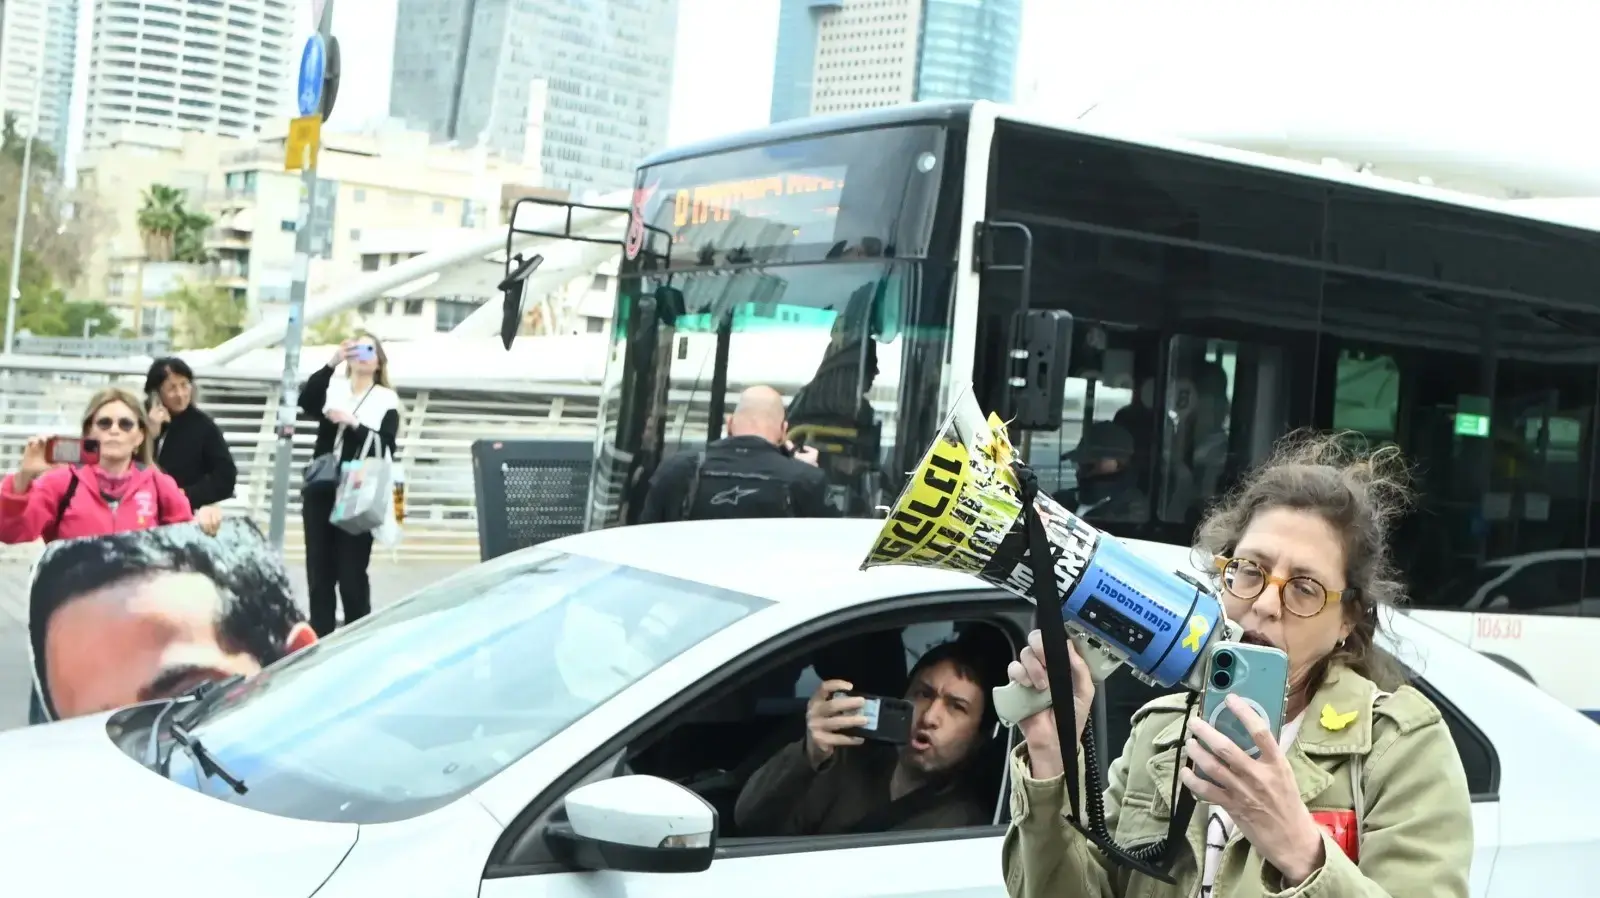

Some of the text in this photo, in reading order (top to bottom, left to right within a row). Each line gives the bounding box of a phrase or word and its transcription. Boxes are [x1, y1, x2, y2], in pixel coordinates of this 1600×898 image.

[1095, 578, 1144, 616] מהספה!
[1143, 610, 1172, 632] קומו
[1478, 618, 1521, 639] 10630
